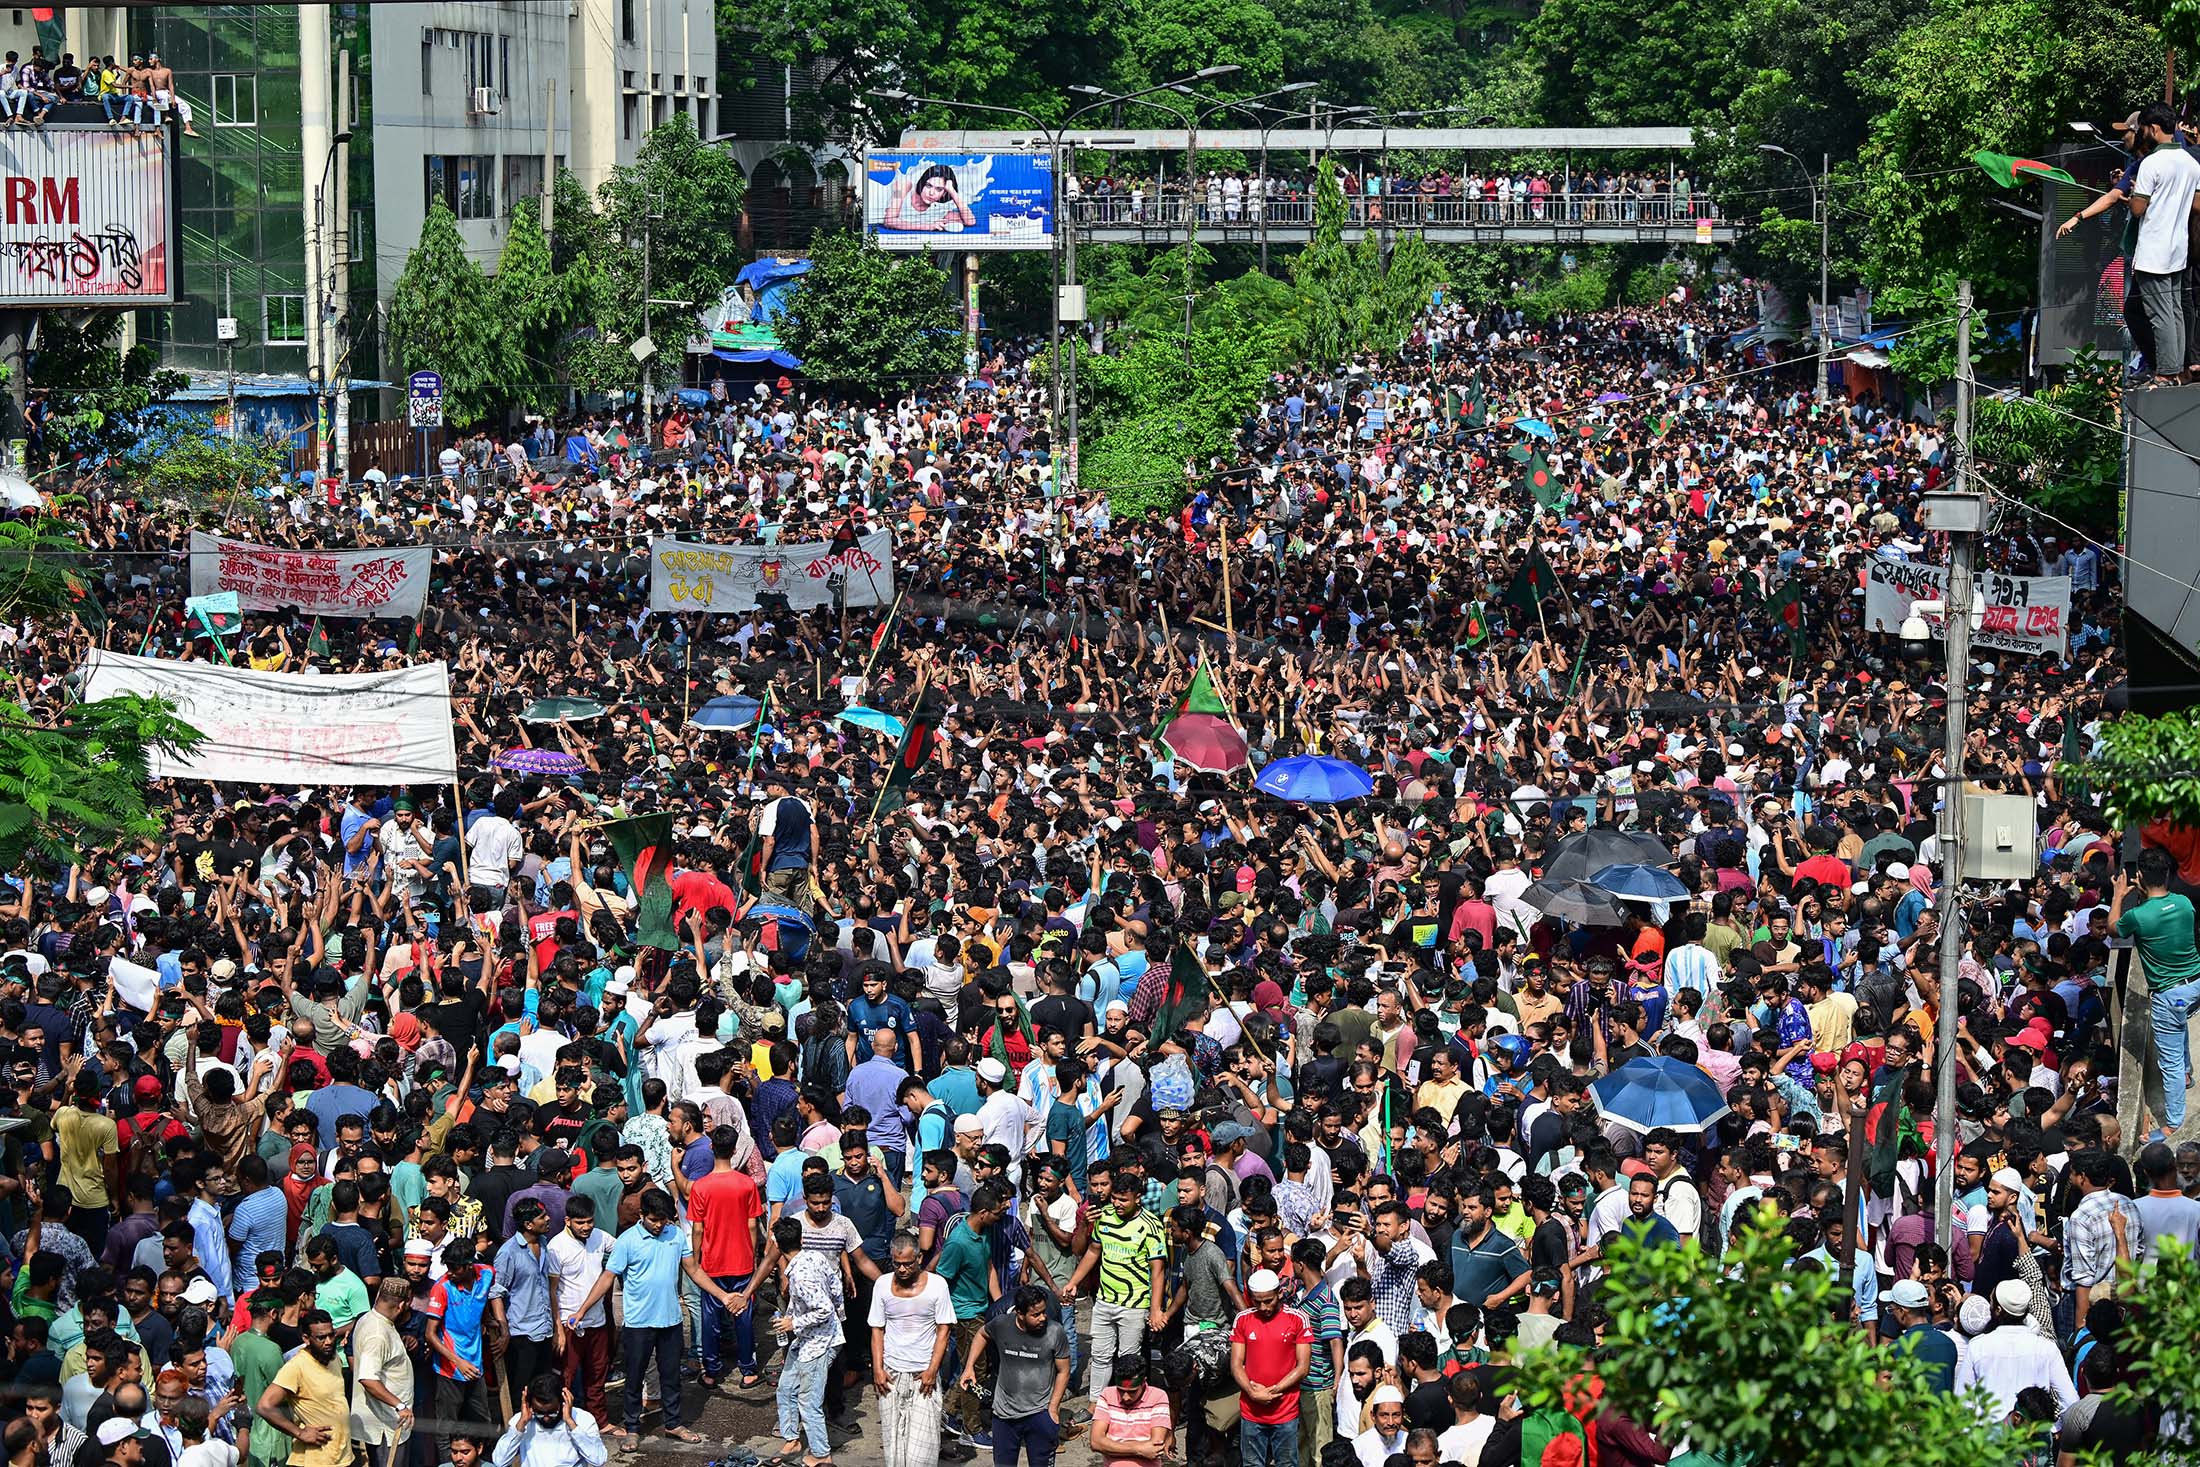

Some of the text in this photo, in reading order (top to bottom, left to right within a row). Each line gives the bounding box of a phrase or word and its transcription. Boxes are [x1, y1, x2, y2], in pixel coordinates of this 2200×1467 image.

[1033, 158, 1051, 167] Meri
[6, 177, 80, 225] RM
[1991, 575, 2029, 608] পতন
[535, 921, 556, 932] FREE
[1104, 1242, 1137, 1256] mirates
